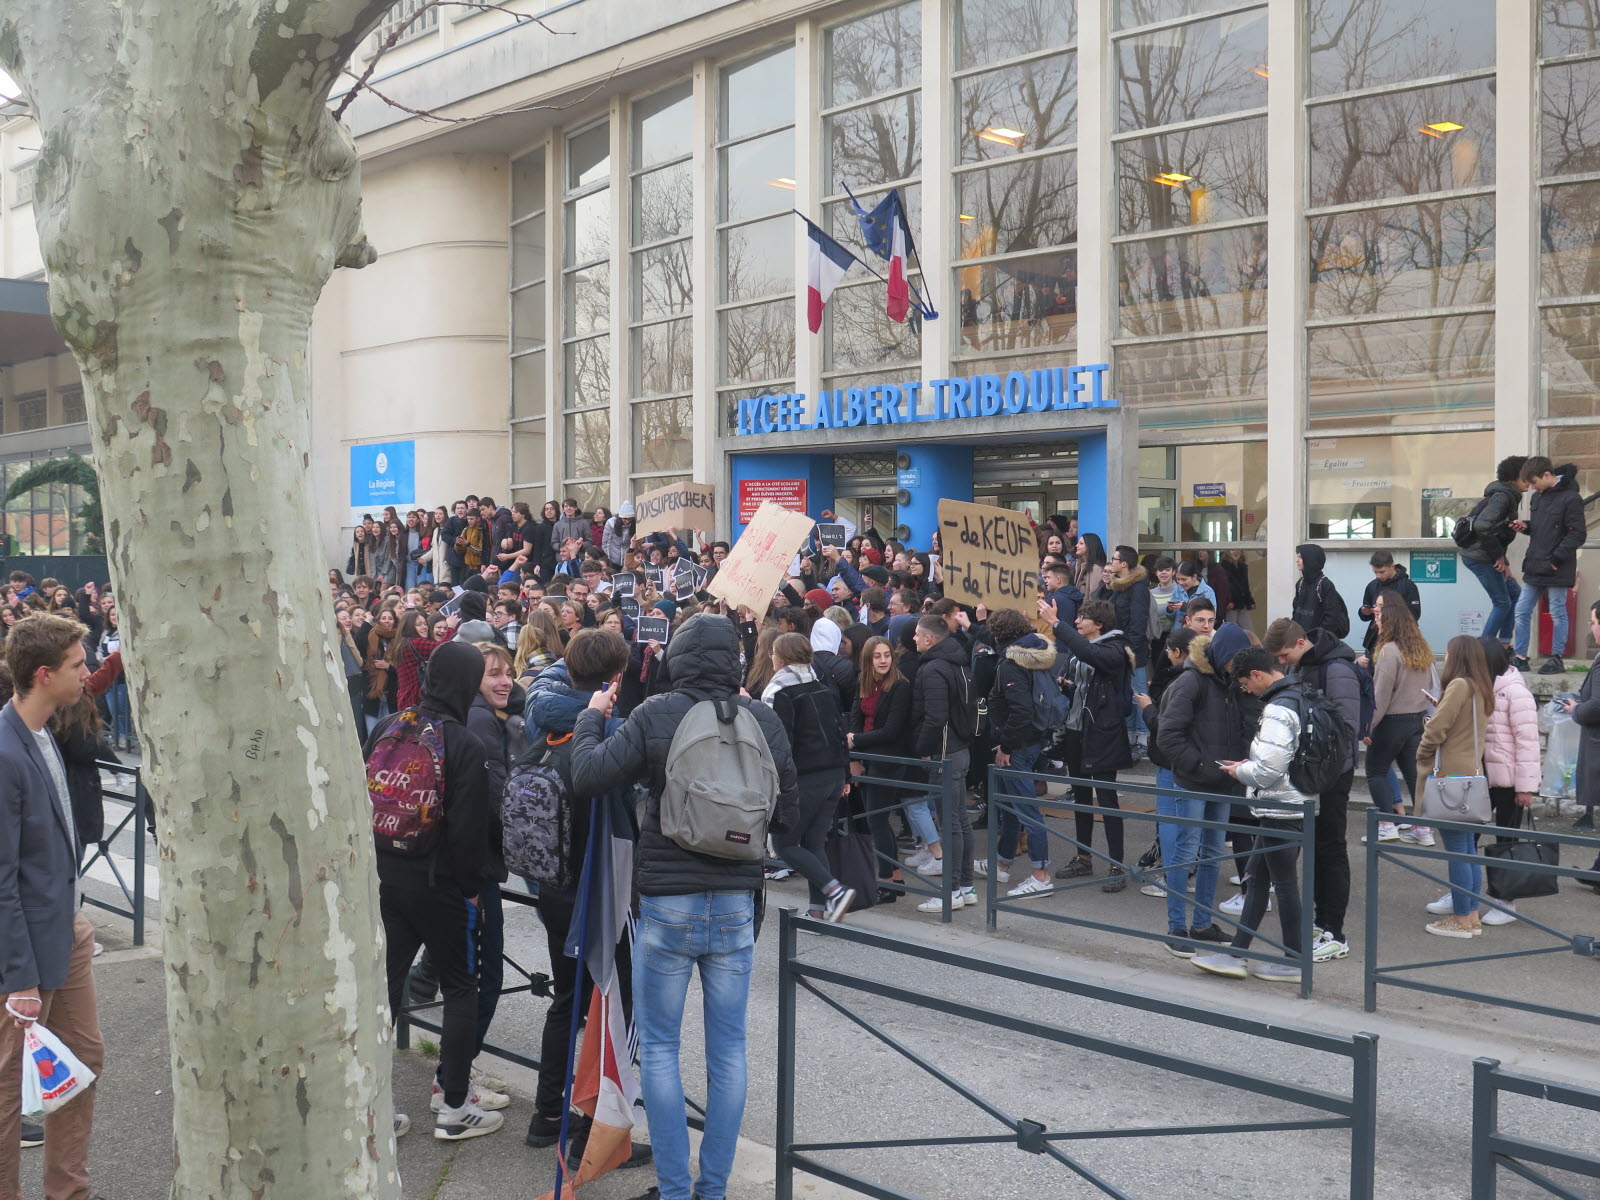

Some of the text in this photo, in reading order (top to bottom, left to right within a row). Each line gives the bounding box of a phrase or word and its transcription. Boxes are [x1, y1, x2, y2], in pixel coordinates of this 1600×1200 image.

[737, 363, 1114, 436] LYCEE ALBERT TRIBOULET
[1324, 459, 1349, 468] Égalité
[1351, 479, 1388, 488] Fraternité
[980, 515, 1032, 556] KEUF
[980, 560, 1038, 598] TEUF
